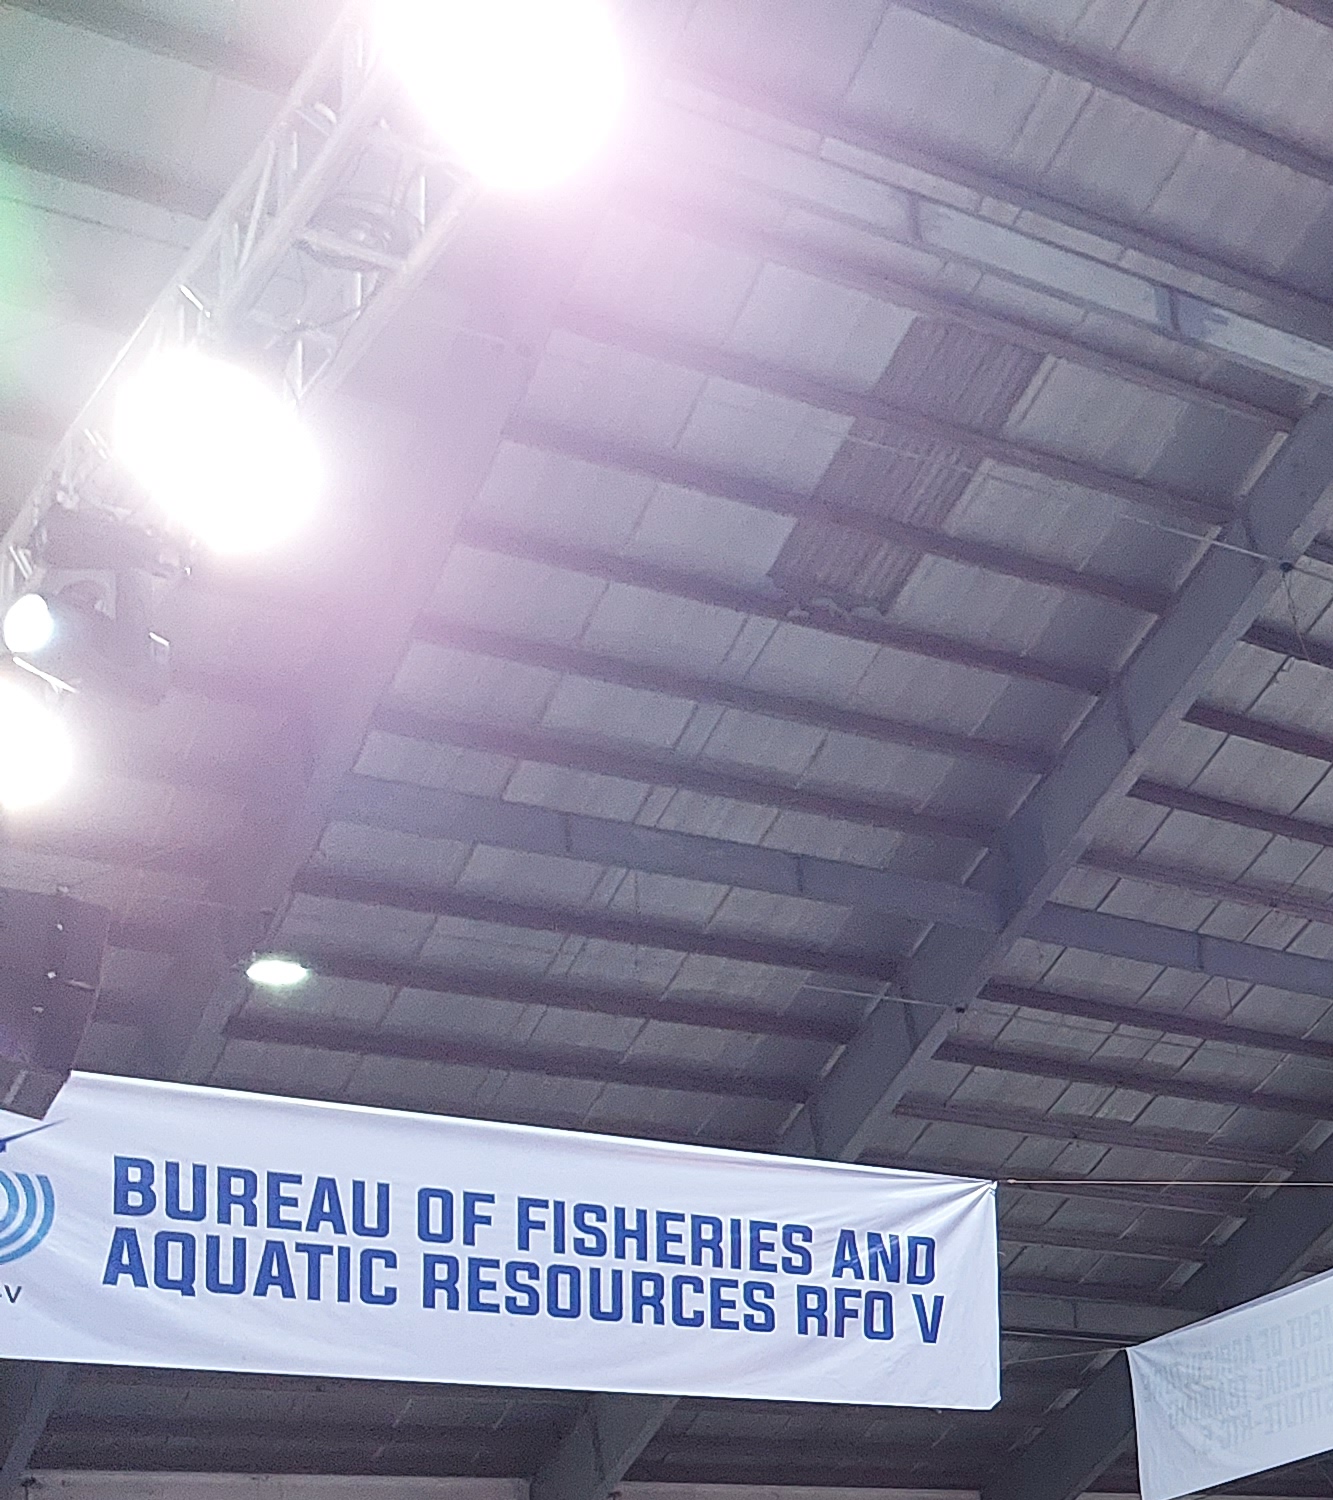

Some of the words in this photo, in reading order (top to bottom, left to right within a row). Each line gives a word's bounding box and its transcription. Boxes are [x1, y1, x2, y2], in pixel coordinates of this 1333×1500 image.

[113, 1155, 392, 1238] BUREAU
[417, 1188, 495, 1248] OF
[515, 1196, 815, 1278] FISHERIES
[831, 1229, 936, 1286] AND
[101, 1226, 399, 1307] AQUATIC
[421, 1254, 777, 1333] RESOURCES
[796, 1286, 896, 1341] RFO
[911, 1294, 945, 1345] V
